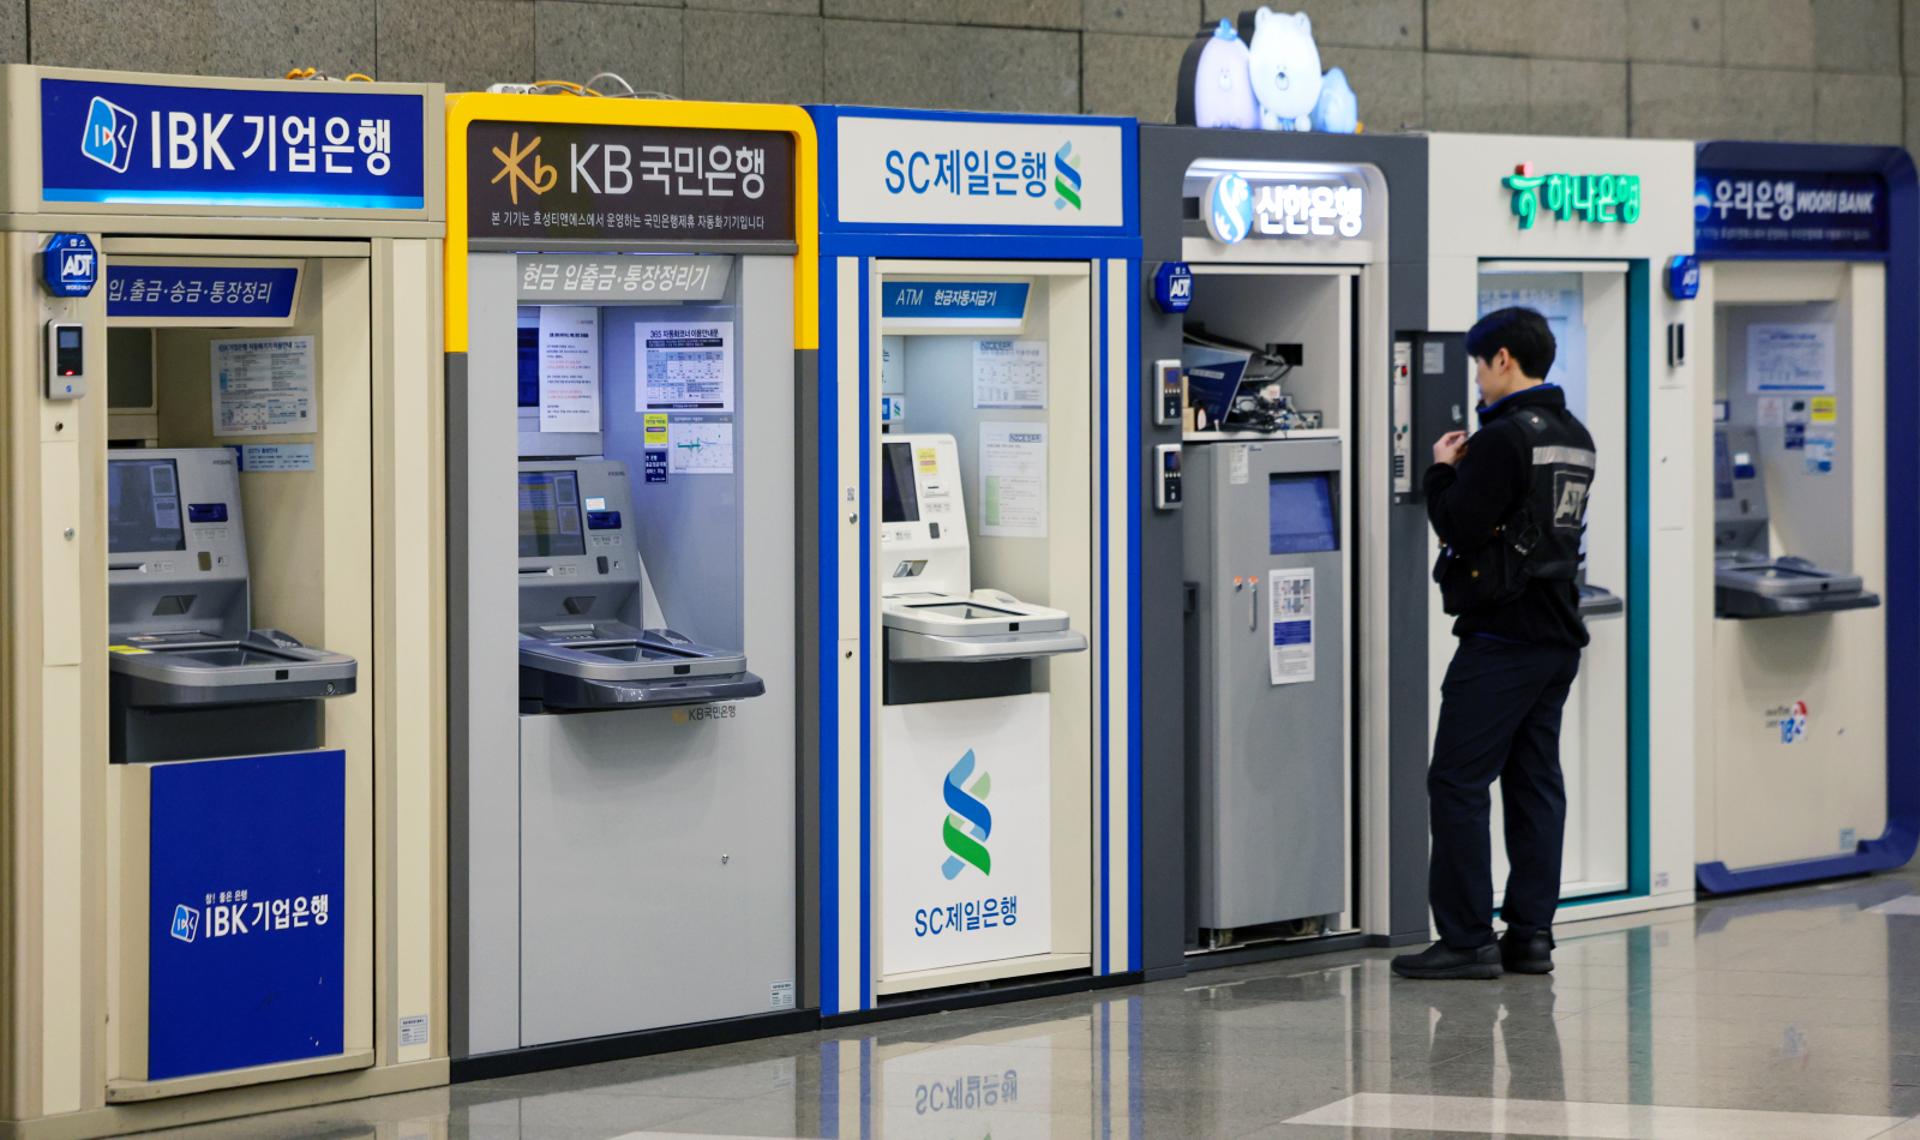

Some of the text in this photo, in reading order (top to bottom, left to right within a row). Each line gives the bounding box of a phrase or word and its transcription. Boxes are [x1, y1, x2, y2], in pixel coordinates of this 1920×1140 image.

[885, 149, 1047, 198] SC제일은행
[1256, 184, 1362, 237] 신한은행
[1546, 173, 1641, 224] 하나은행
[1713, 180, 1796, 221] 우리은행
[1837, 191, 1875, 214] BANK
[491, 211, 501, 226] 본
[504, 211, 530, 227] 기기는
[606, 212, 642, 228] 운영하는
[644, 213, 695, 229] 국민은행제휴
[697, 214, 765, 230] 자동화기기입니다
[62, 254, 93, 276] ADT
[523, 263, 559, 291] 현금
[895, 288, 997, 306] ATM 현금자동지급기
[1170, 278, 1191, 297] ADT
[914, 895, 1017, 937] SC제일은행
